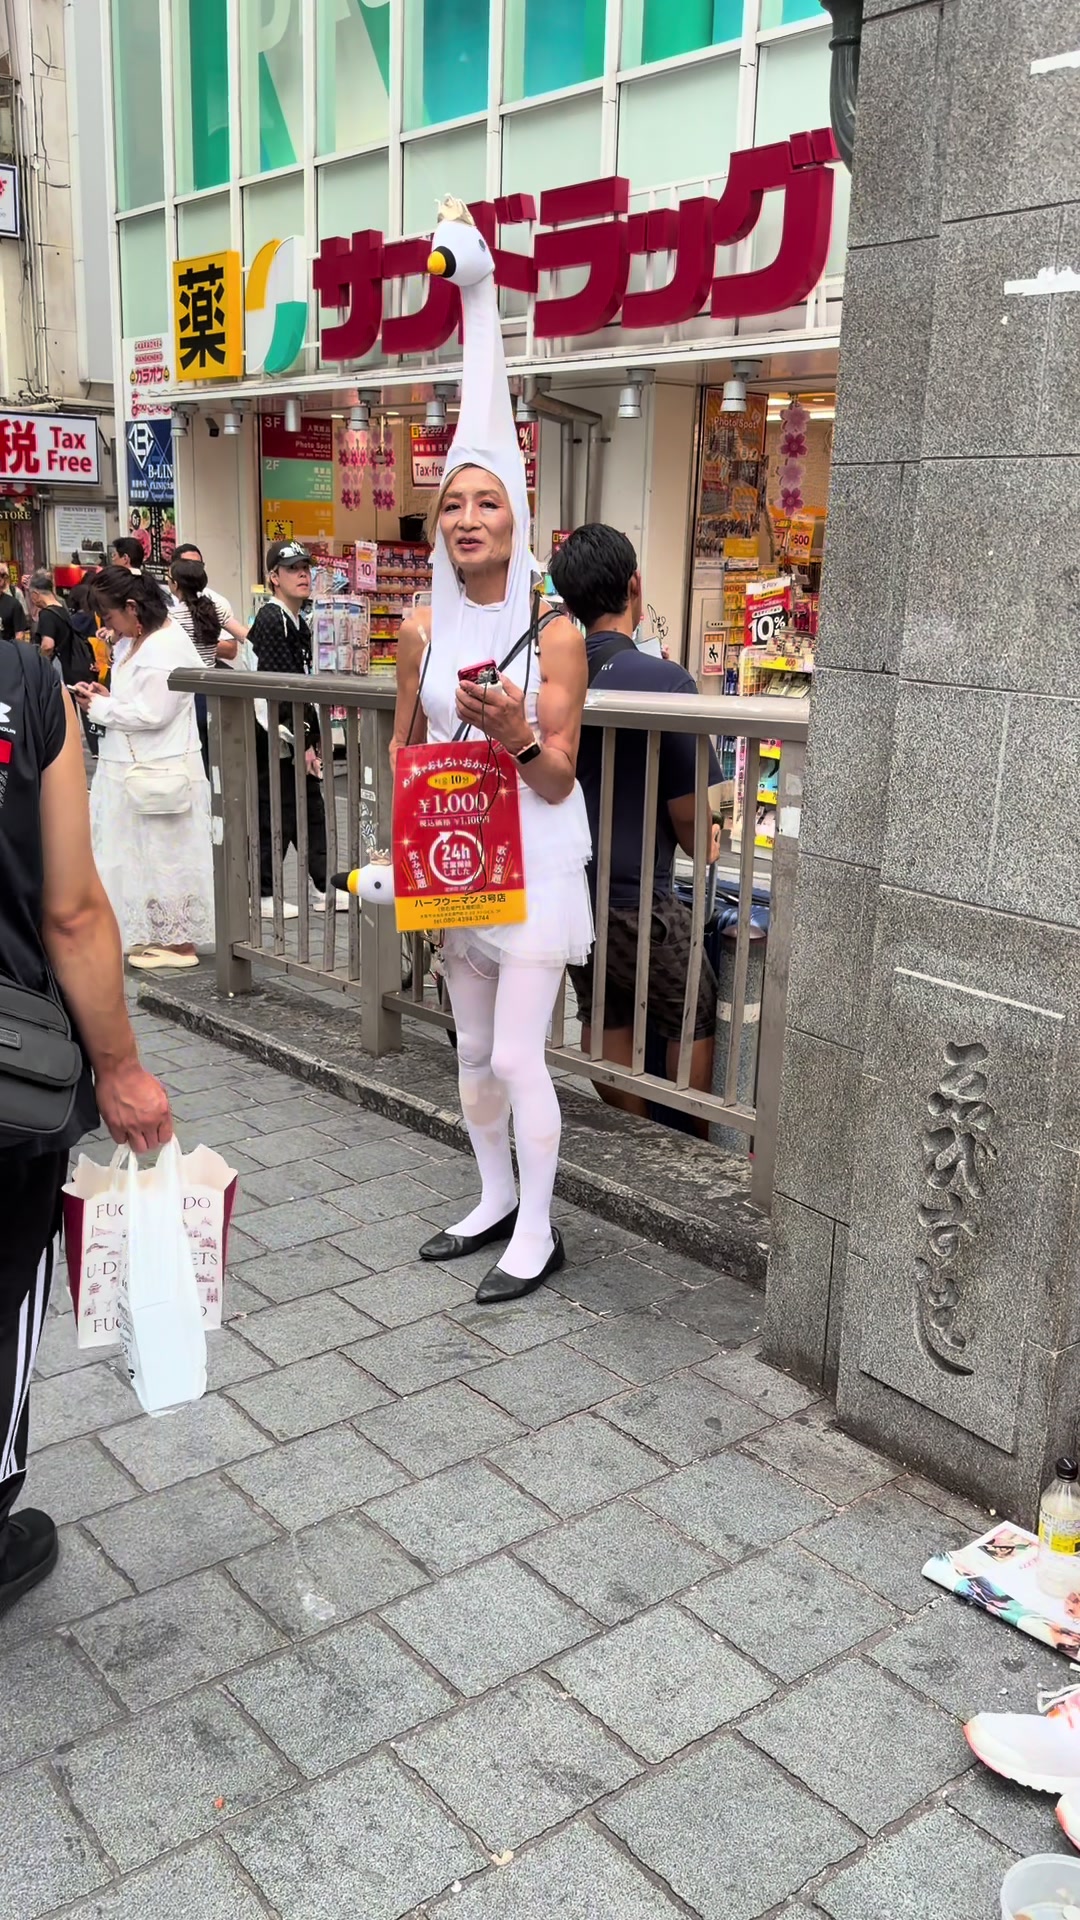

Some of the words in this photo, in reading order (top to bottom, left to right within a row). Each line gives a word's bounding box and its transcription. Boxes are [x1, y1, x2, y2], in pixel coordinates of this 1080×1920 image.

[178, 264, 226, 370] 薬
[135, 366, 164, 384] カラオケ
[265, 417, 281, 428] 3F
[714, 416, 737, 427] Photo
[739, 419, 759, 429] Spot
[0, 419, 40, 473] 税
[49, 426, 86, 449] Tax
[47, 450, 92, 472] Free
[266, 460, 280, 470] 2F
[415, 463, 444, 477] Tax-fre
[148, 464, 173, 479] B-LIN
[419, 791, 489, 815] ¥1,000
[441, 843, 471, 861] 24h
[414, 893, 506, 908] ハーフウーマン3号店
